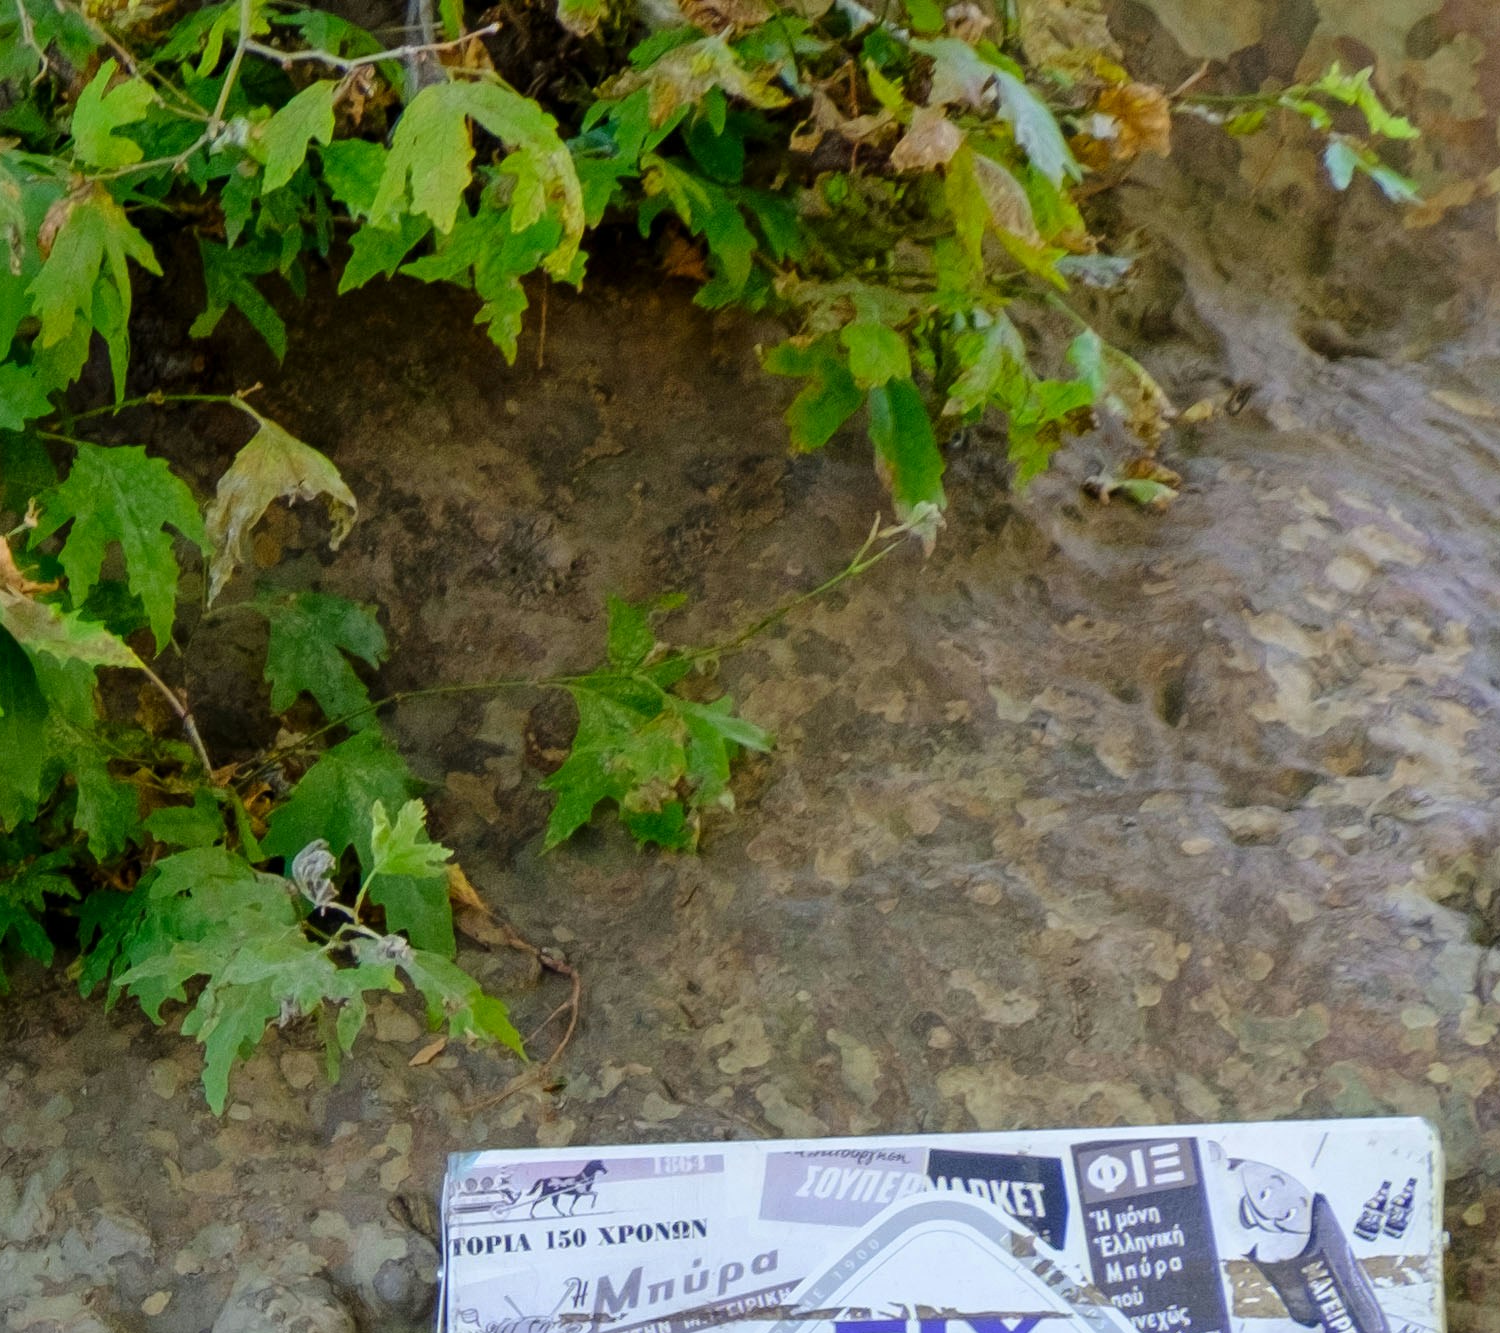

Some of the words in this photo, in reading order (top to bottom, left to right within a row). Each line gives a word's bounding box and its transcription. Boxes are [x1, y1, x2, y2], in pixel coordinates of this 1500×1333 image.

[1087, 1143, 1185, 1193] ΦΙΞ
[546, 1228, 587, 1250] 150
[597, 1218, 709, 1247] ΧΡΟΝΩΝ
[1115, 1204, 1162, 1232] μόνη
